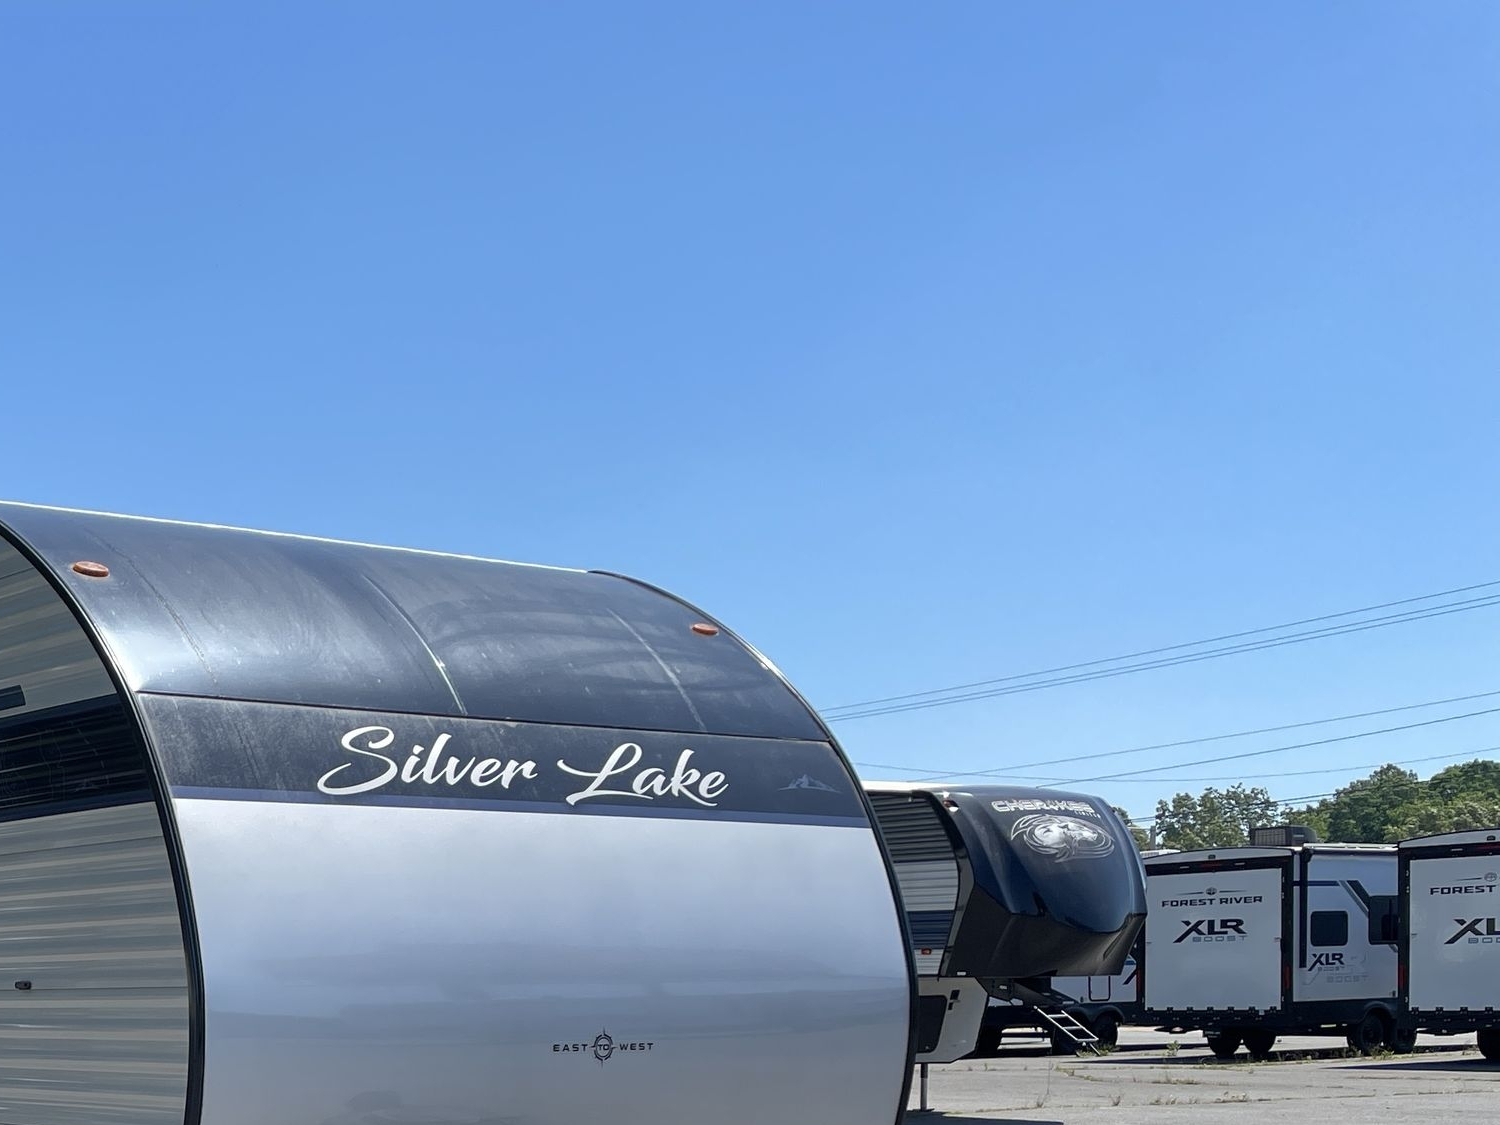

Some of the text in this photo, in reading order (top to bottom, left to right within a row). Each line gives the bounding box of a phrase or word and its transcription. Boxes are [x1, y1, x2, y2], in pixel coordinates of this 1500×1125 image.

[317, 725, 730, 807] Silver Lake
[991, 799, 1095, 813] CHEROKEE
[1429, 885, 1497, 896] FOREST
[1161, 896, 1263, 908] FOREST RIVER
[1173, 918, 1247, 944] XLR
[1444, 917, 1500, 945] XL
[1192, 935, 1248, 943] BOOST
[1307, 952, 1345, 971] XLR
[552, 1043, 588, 1052] EAST
[619, 1042, 654, 1051] WEST
